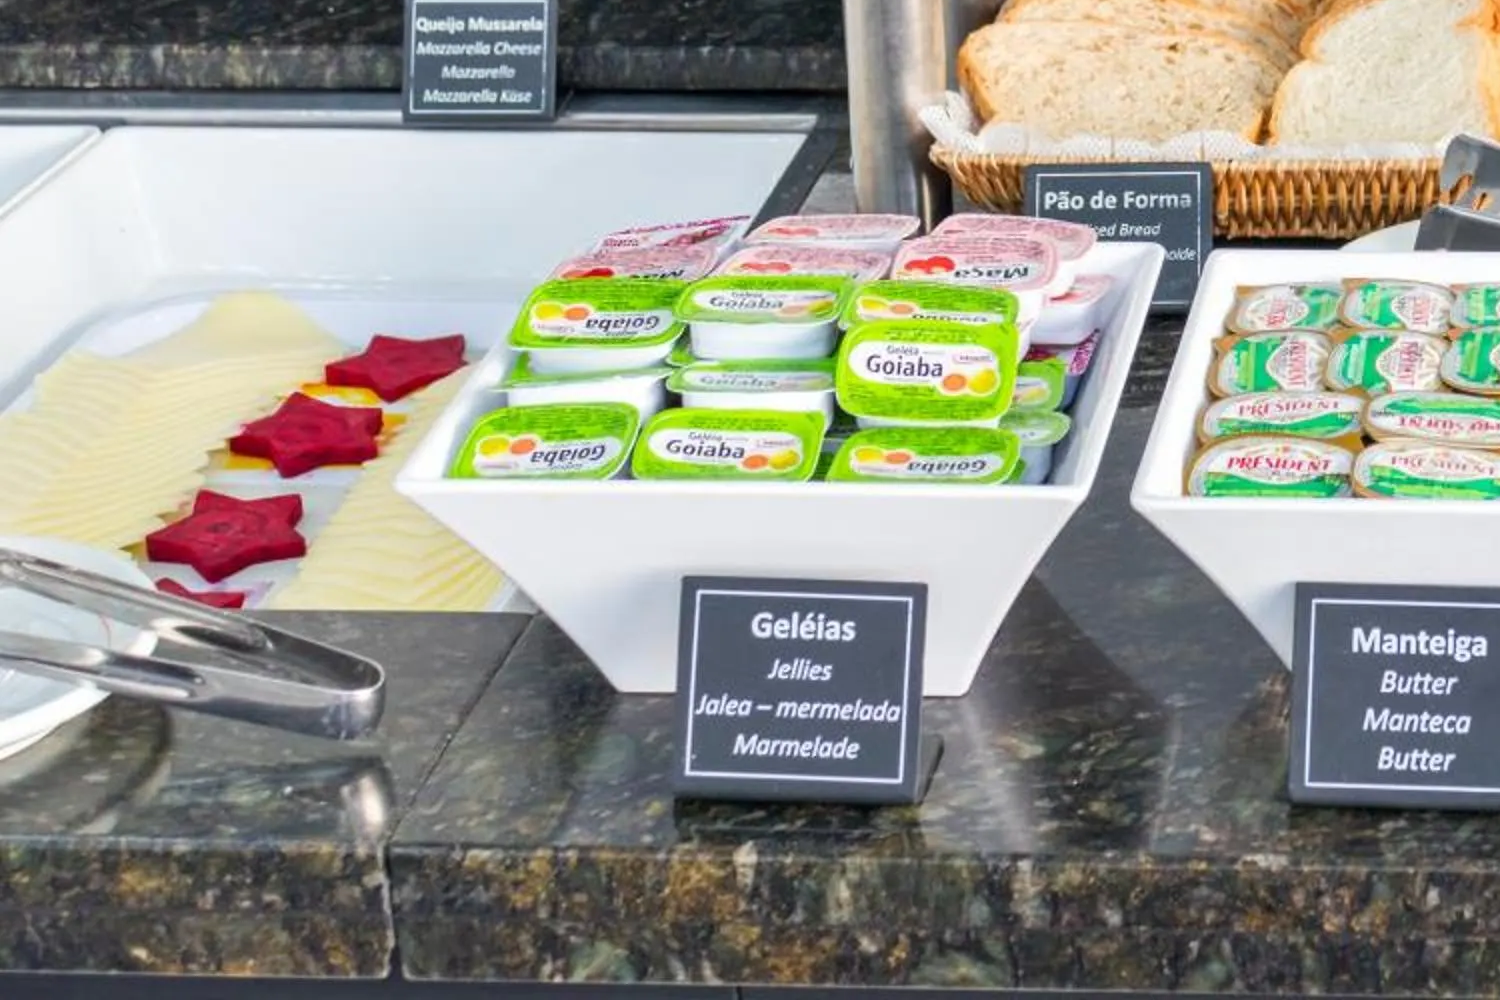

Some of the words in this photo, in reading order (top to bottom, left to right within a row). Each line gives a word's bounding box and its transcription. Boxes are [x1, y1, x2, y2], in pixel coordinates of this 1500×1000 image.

[415, 16, 465, 34] Queijo
[467, 16, 544, 31] Mussarela
[493, 41, 542, 56] Cheese
[1043, 190, 1084, 211] Pão
[1090, 190, 1117, 209] de
[1122, 191, 1192, 209] Forma
[1119, 223, 1161, 237] Bread
[709, 295, 784, 310] Goiaba
[585, 314, 661, 330] Goiaba
[866, 354, 943, 377] Goiaba
[530, 444, 606, 463] Goiaba
[665, 438, 746, 460] Goiaba
[907, 459, 987, 472] Goiaba
[751, 611, 856, 641] Geléias
[1351, 626, 1488, 662] Manteiga
[767, 658, 833, 681] Jellies
[1380, 670, 1459, 695] Butter
[695, 693, 751, 716] Jalea
[776, 699, 902, 723] mermelada
[1363, 707, 1472, 734] Manteca
[732, 733, 860, 759] Marmelade
[1377, 746, 1457, 772] Butter
